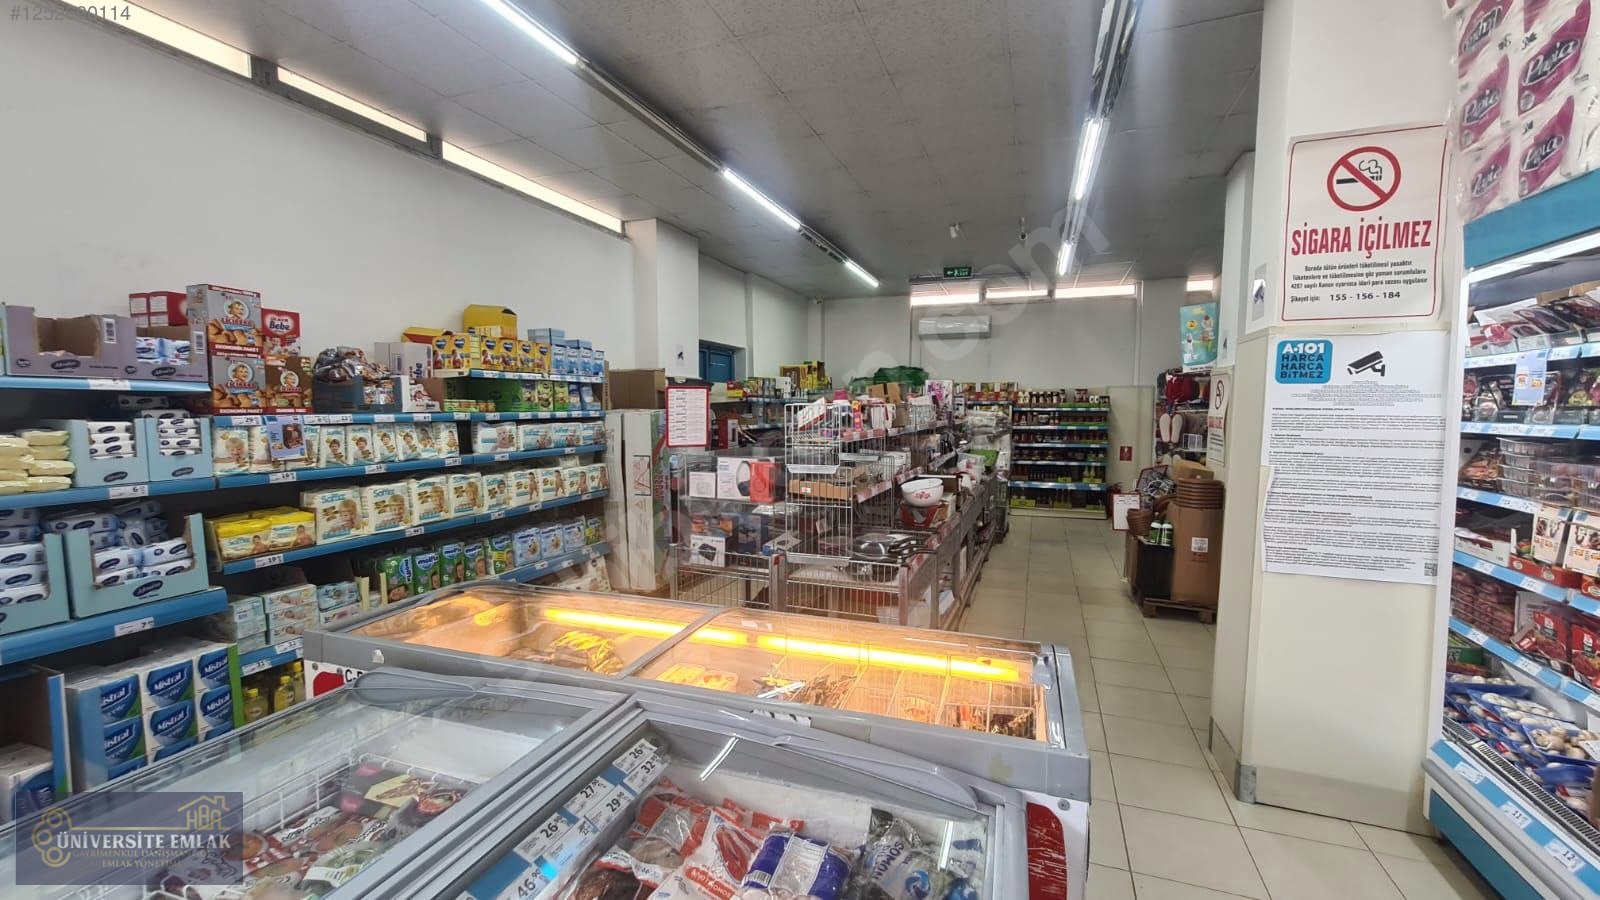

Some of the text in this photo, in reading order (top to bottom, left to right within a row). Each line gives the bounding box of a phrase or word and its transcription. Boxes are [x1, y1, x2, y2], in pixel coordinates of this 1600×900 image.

[1291, 215, 1432, 259] SİGARA İÇİLMEZ
[1330, 294, 1347, 302] 155
[1356, 292, 1374, 300] 156
[269, 321, 290, 331] Bebe
[1281, 354, 1324, 362] HARCA
[1280, 362, 1324, 370] HARCA
[153, 670, 182, 692] Mistral
[102, 687, 126, 706] istral
[157, 710, 186, 730] Mistral
[103, 728, 130, 750] istral
[640, 760, 656, 774] 32
[580, 785, 595, 799] 27
[606, 798, 621, 812] 29
[540, 823, 558, 838] 26
[517, 878, 536, 898] 46
